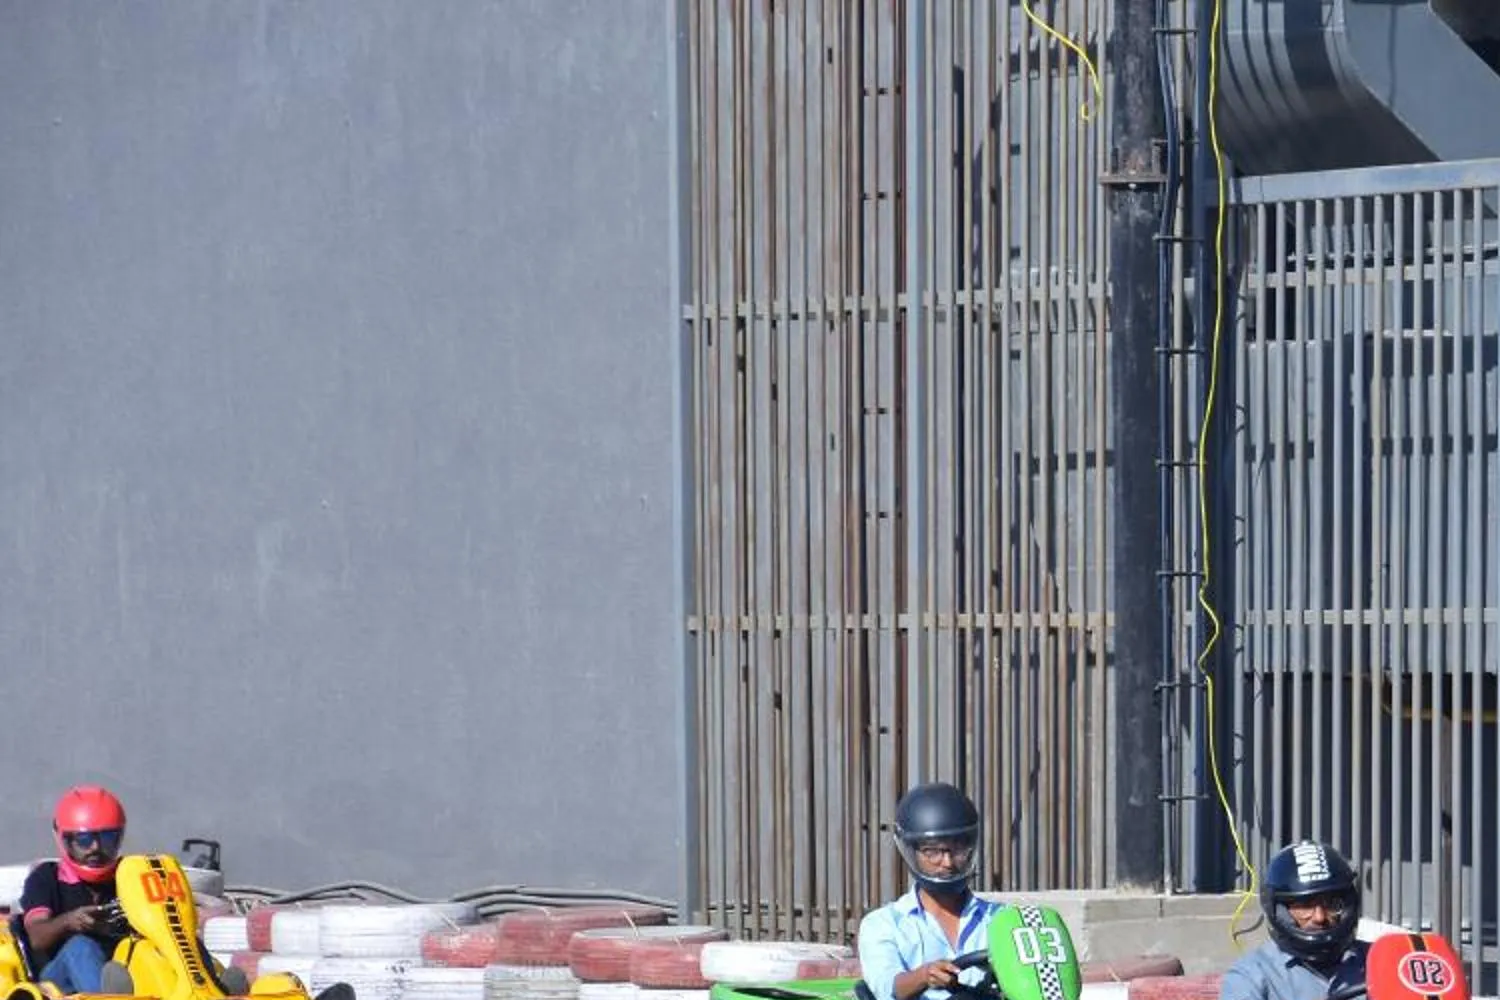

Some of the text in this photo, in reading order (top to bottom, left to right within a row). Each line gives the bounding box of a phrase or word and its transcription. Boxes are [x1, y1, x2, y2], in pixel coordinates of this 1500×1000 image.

[140, 871, 186, 904] 04
[1011, 927, 1067, 964] 03
[1409, 958, 1445, 985] 02
